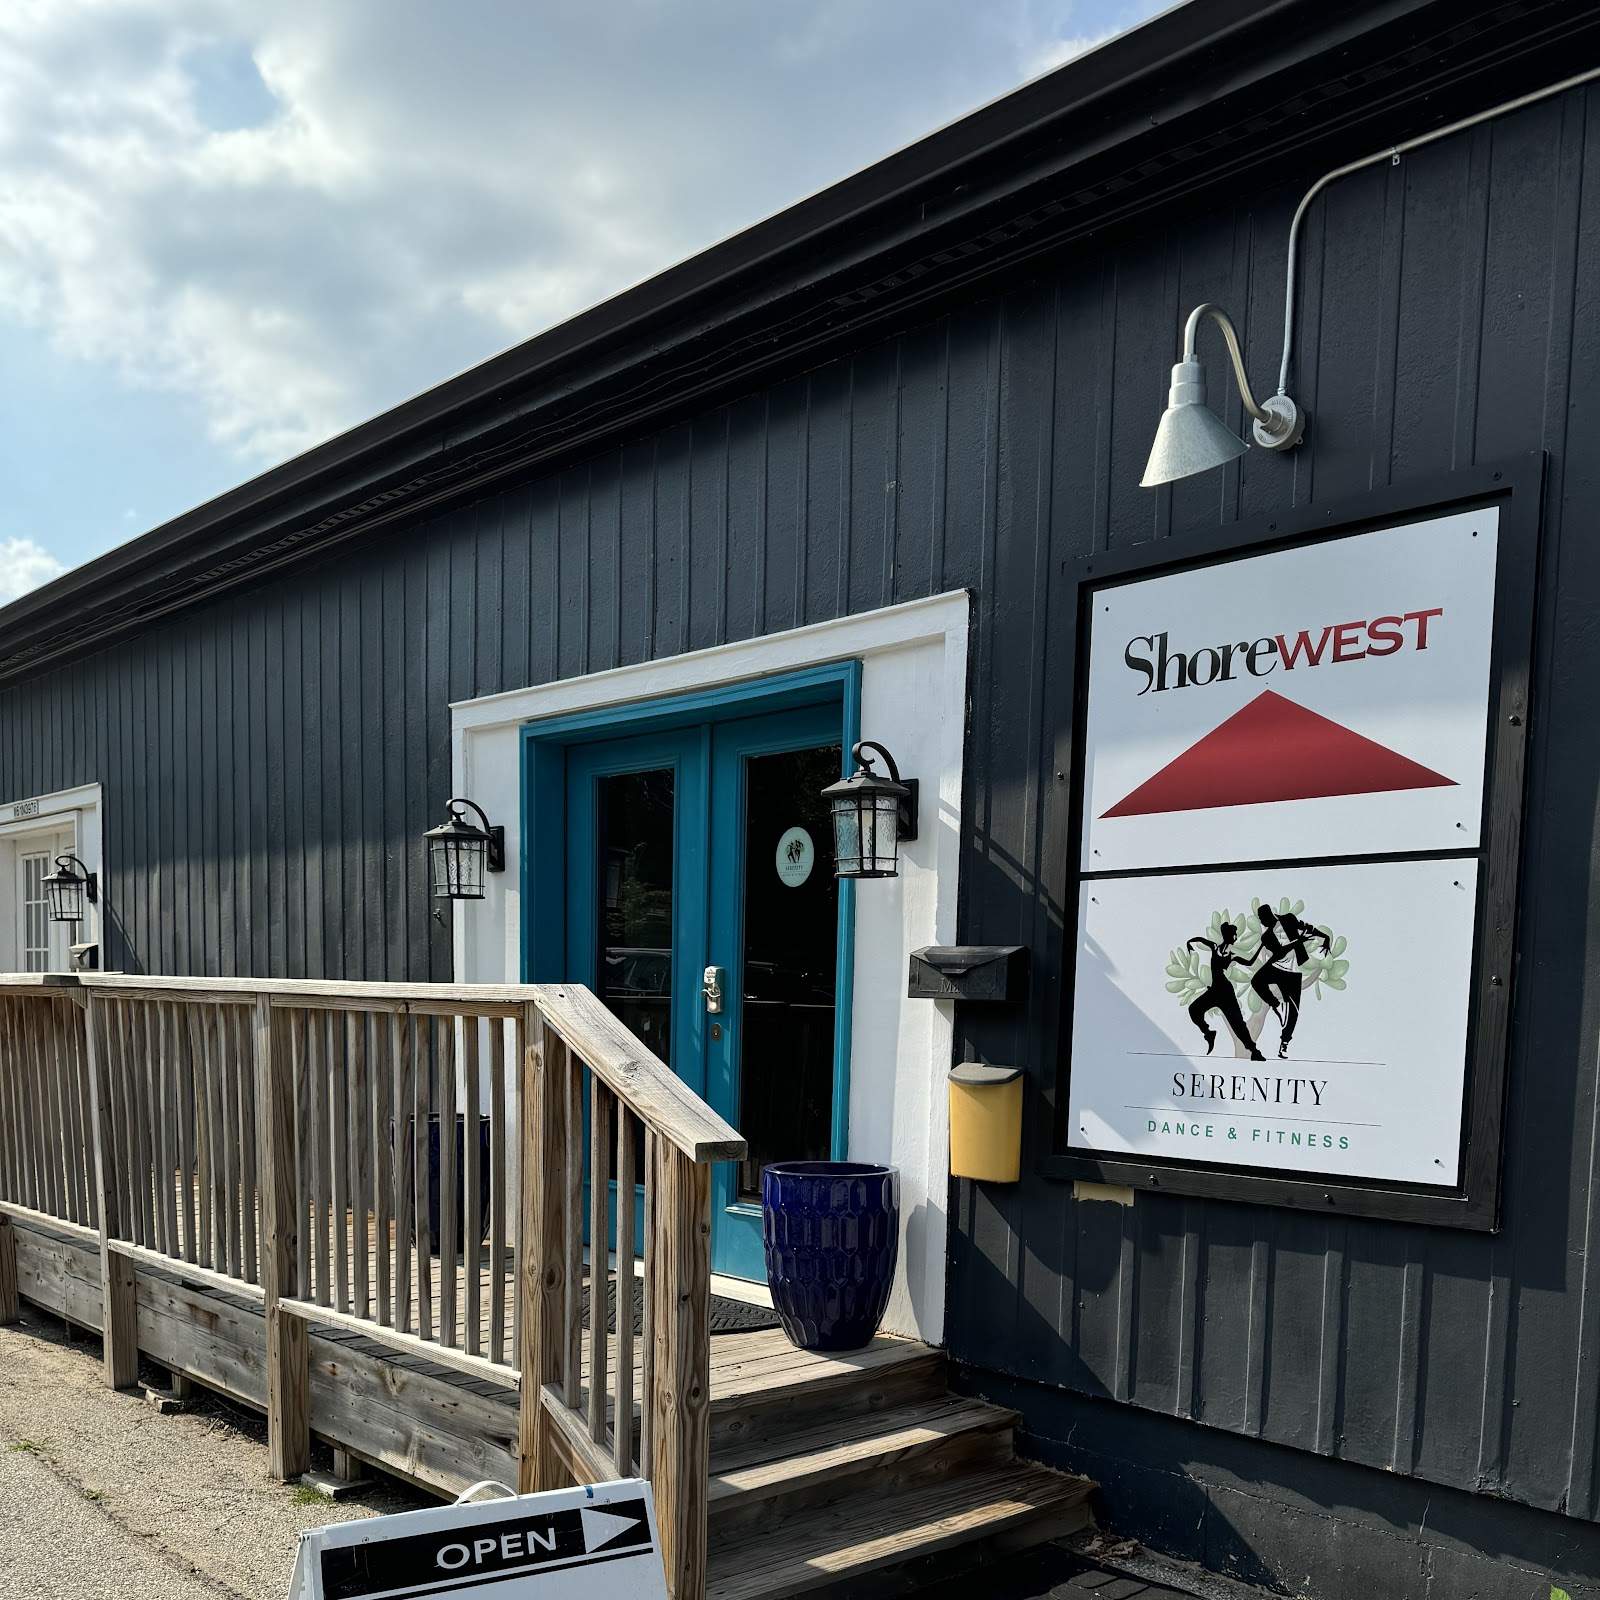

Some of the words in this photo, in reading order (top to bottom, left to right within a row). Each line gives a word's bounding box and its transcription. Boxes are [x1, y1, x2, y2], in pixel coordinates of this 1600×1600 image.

[1124, 607, 1443, 696] ShoreWEST
[1172, 1072, 1328, 1106] SERENITY
[1148, 1120, 1214, 1138] DANCE
[1227, 1127, 1237, 1140] &
[1252, 1129, 1350, 1150] FITNESS
[436, 1527, 557, 1570] OPEN
